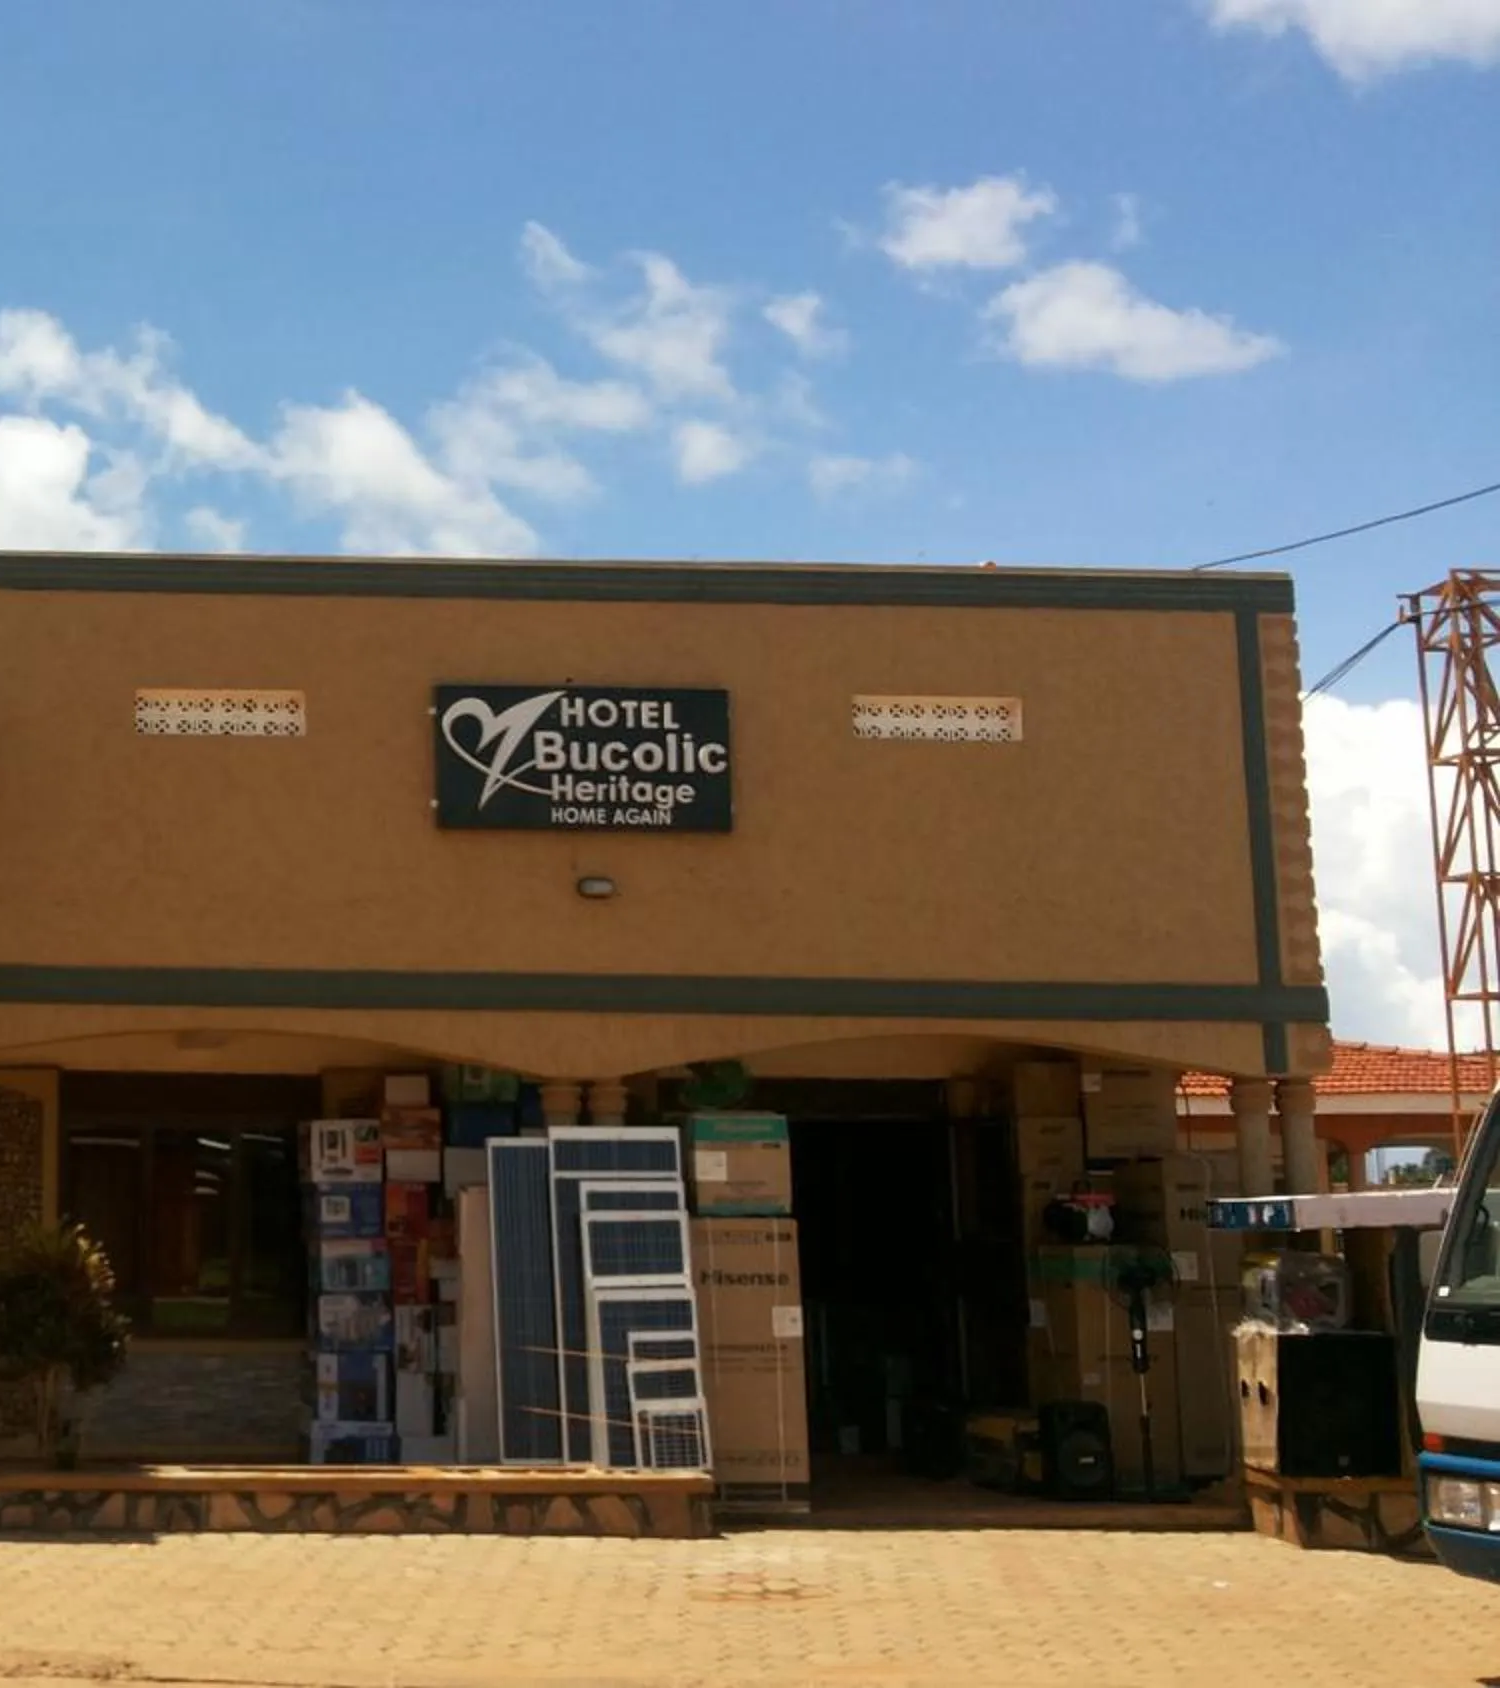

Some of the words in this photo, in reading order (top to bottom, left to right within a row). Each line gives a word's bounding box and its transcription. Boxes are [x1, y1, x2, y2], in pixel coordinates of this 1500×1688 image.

[560, 697, 680, 729] HOTEL
[534, 730, 728, 773] Bucolic
[551, 773, 696, 809] Heritage
[551, 807, 607, 824] HOME
[612, 808, 672, 825] AGAIN
[700, 1268, 790, 1287] Hisense
